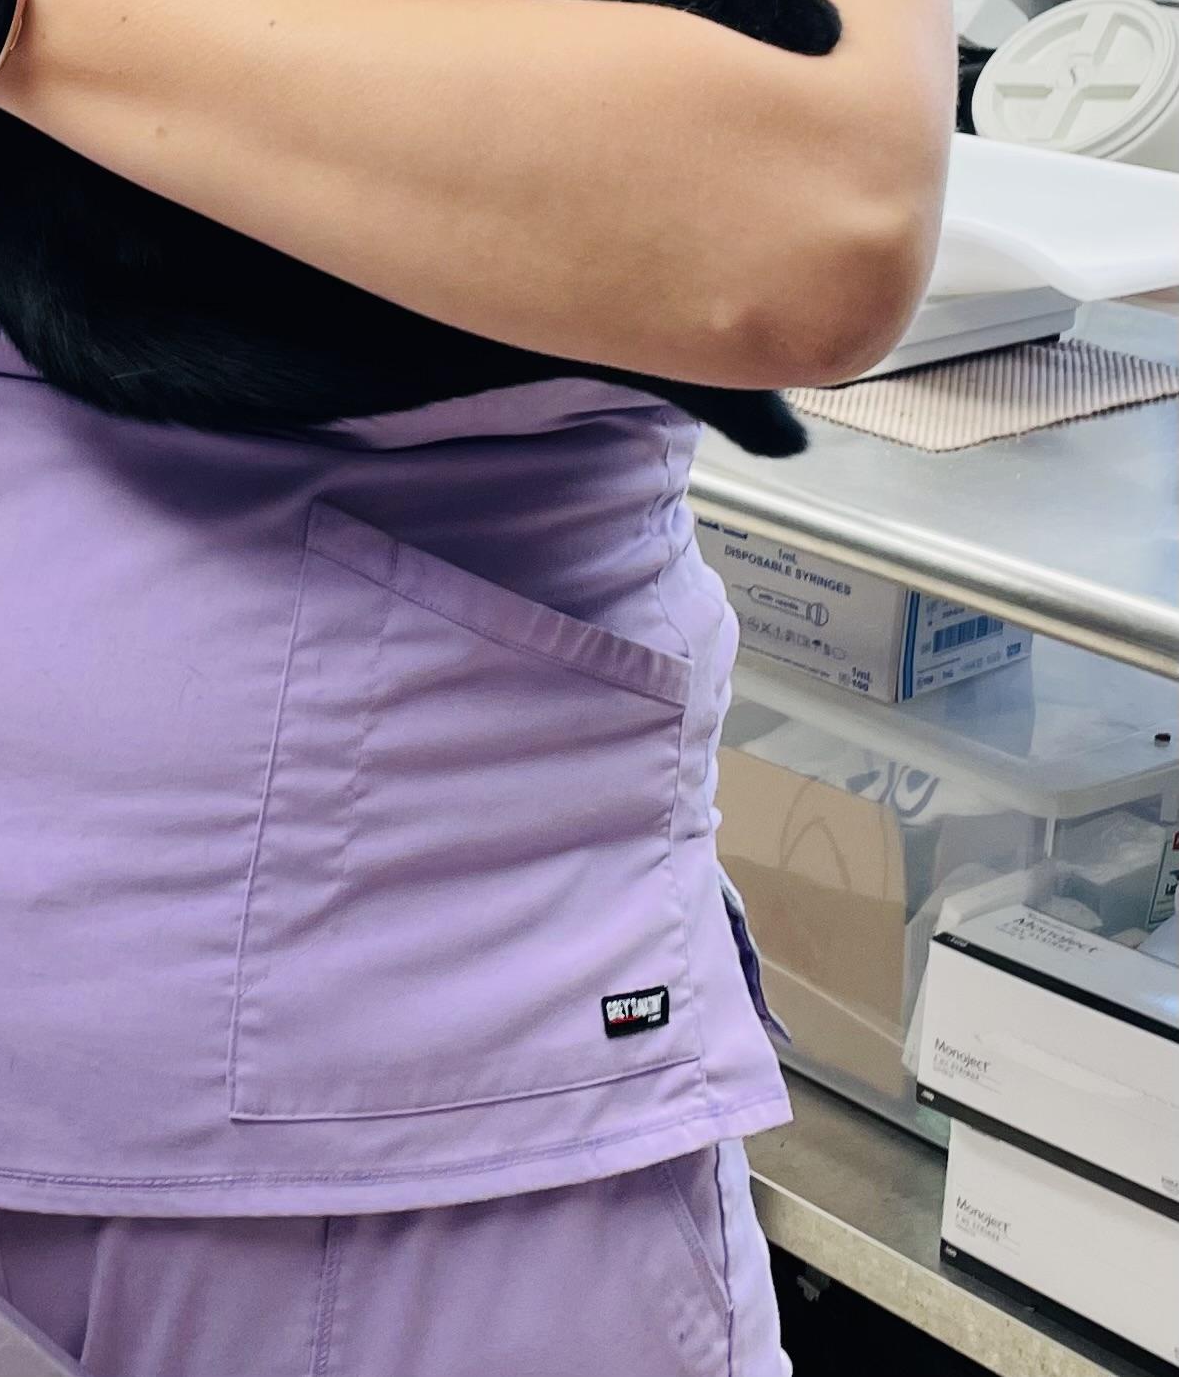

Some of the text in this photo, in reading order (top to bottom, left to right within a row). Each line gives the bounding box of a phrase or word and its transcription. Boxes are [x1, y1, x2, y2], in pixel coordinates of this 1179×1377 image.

[724, 544, 852, 597] DISPOSABLE SYRINGES
[934, 1036, 991, 1074] Monoject
[956, 1194, 1011, 1233] Monoject
